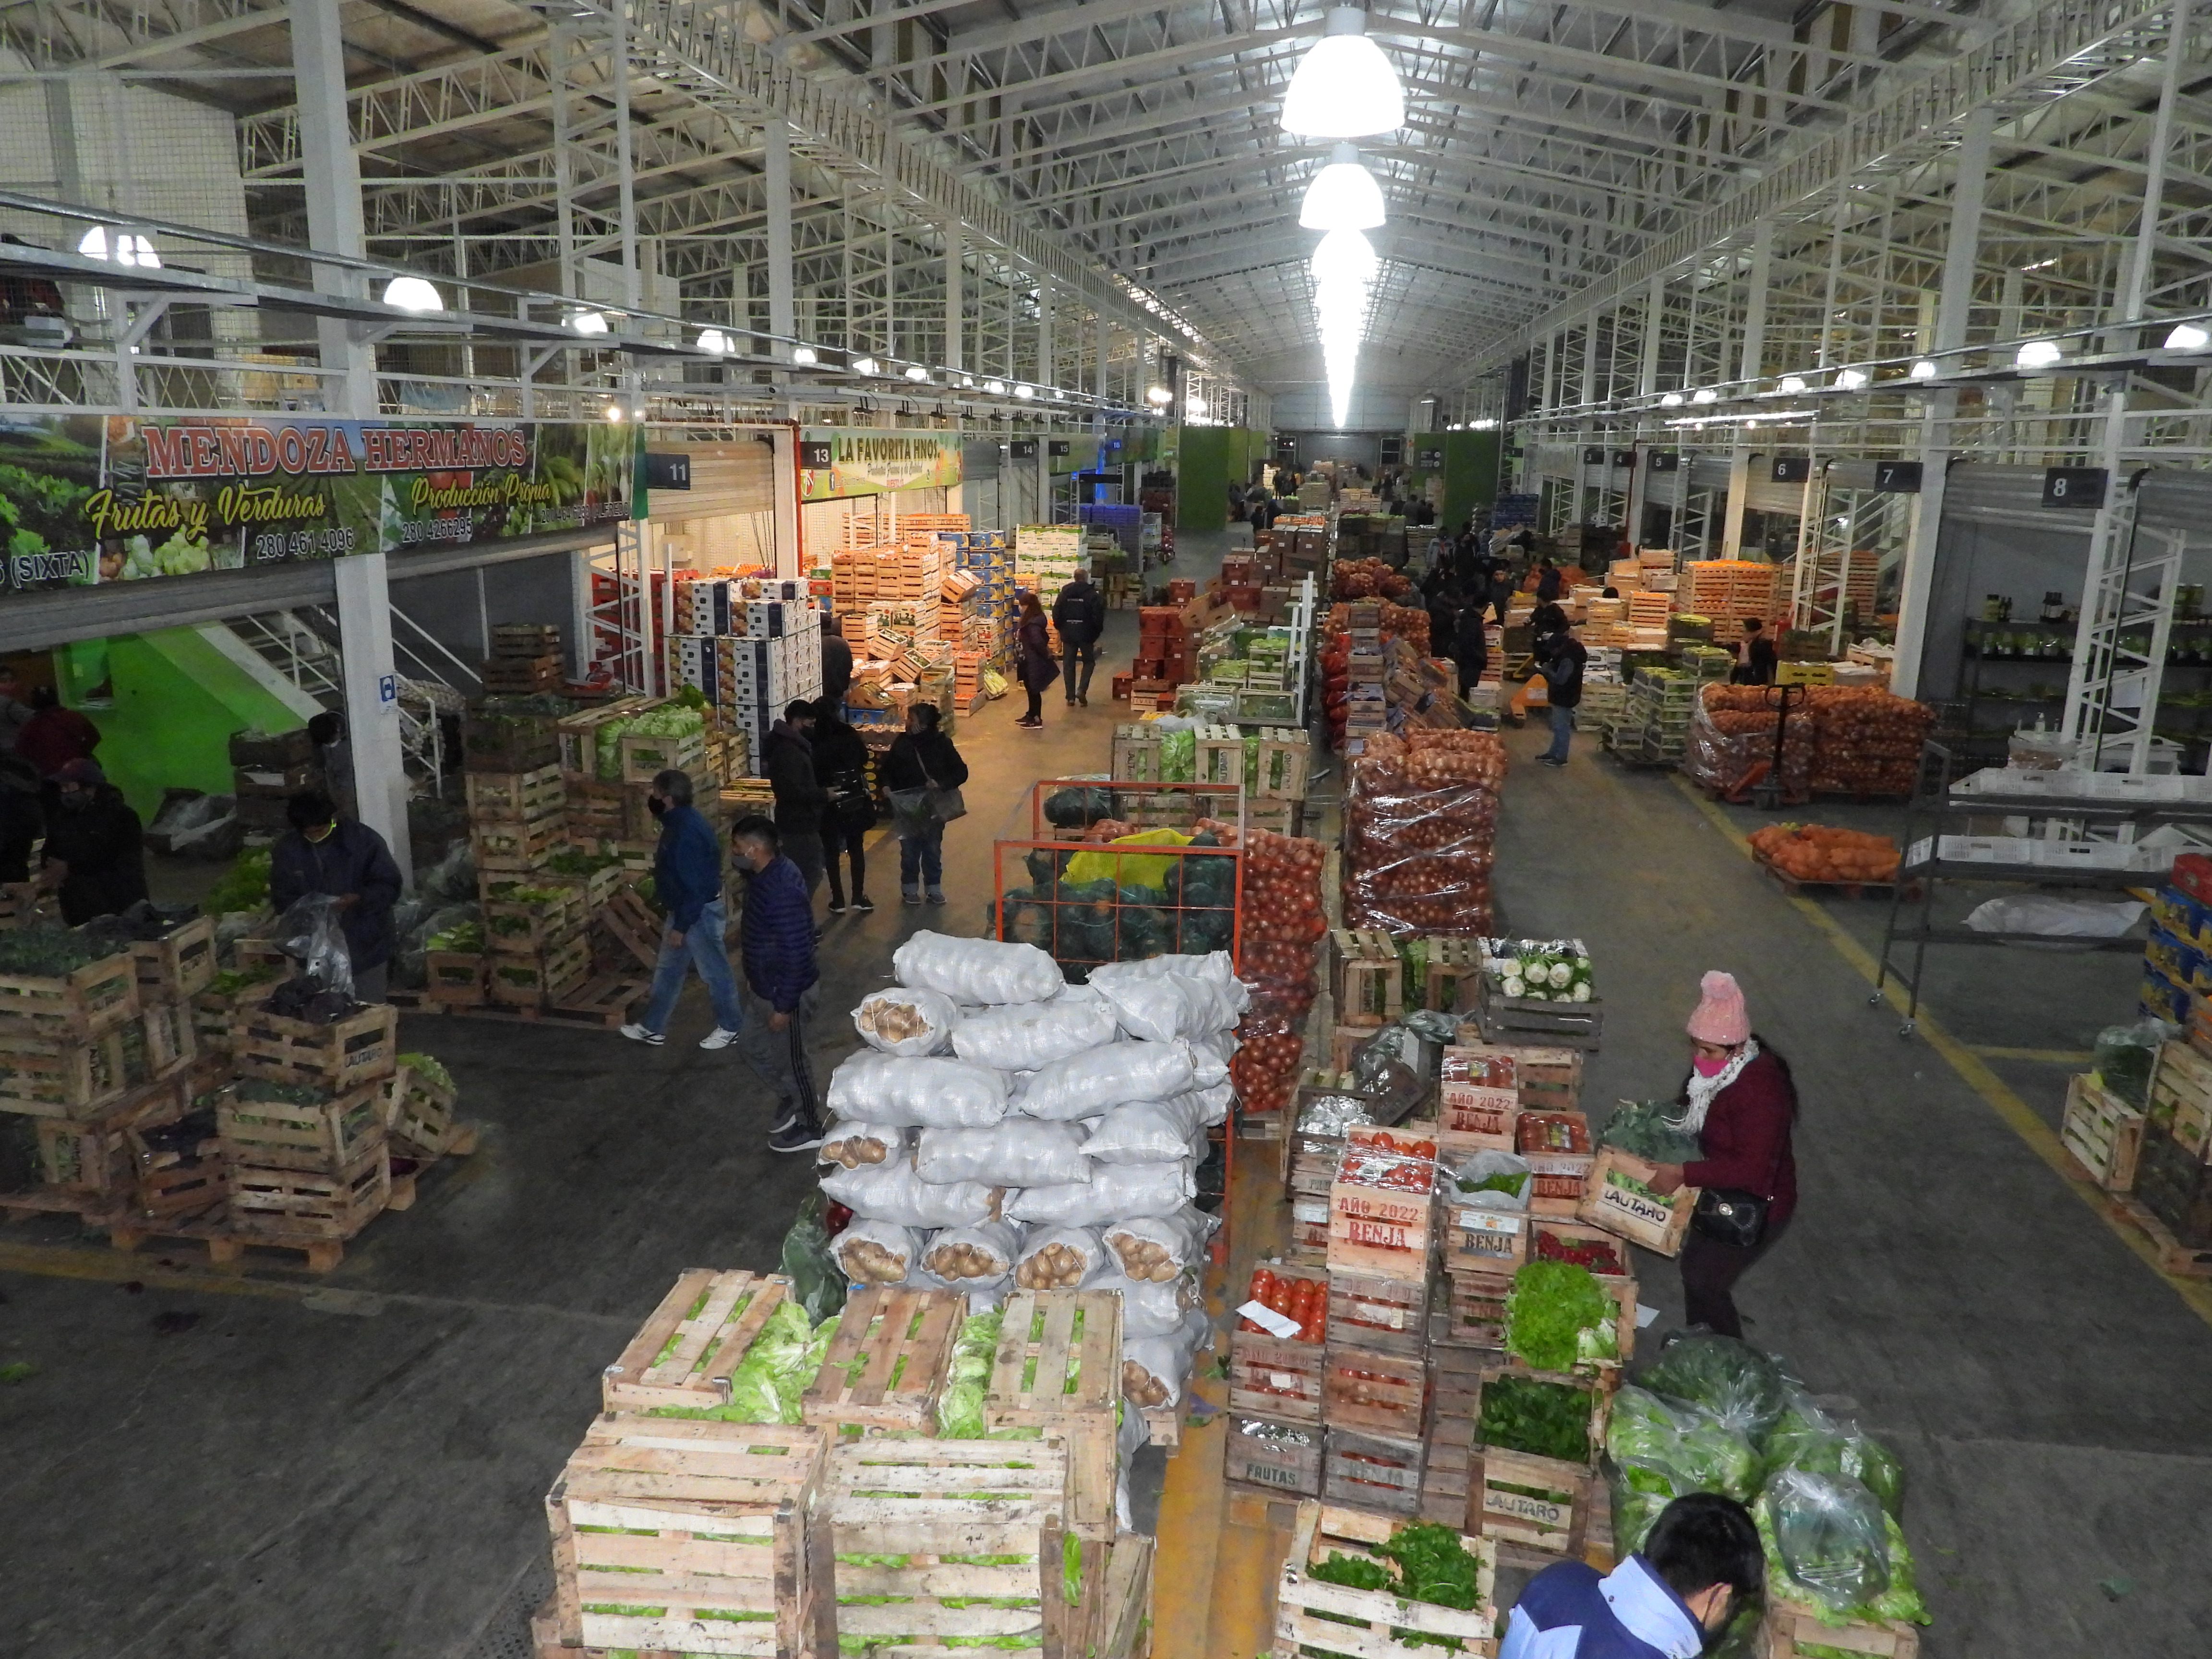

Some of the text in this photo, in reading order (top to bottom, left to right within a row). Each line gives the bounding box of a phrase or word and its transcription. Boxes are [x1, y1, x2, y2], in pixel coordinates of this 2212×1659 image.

[141, 425, 527, 479] MENDOZA HERMANOS
[814, 448, 830, 463] 13
[838, 437, 940, 463] LA FAVORITA HNOS.
[1023, 445, 1033, 455] 14
[1059, 445, 1069, 453] 15
[1616, 455, 1622, 463] 4
[669, 462, 687, 481] 11
[1655, 457, 1662, 467] 5
[1778, 464, 1786, 476] 6
[1883, 469, 1894, 484] 7
[410, 473, 552, 516] Producción Propia
[2053, 478, 2068, 497] 8
[85, 482, 326, 541] Frutas y Verduras
[541, 508, 555, 524] 280
[401, 517, 474, 543] 280 4266295
[256, 527, 356, 560] 280 461 4096
[11, 550, 90, 589] (SIXTA)
[1219, 752, 1228, 783] AUTARO
[1449, 1092, 1512, 1110] AÑO 2022
[1537, 1179, 1581, 1196] BENJA
[1339, 1197, 1419, 1221] AÑO 2022
[1349, 1221, 1407, 1248] BENJA
[1465, 1234, 1513, 1254] BENJA
[1246, 1462, 1296, 1485] FRUTAS
[1485, 1493, 1560, 1521] LAUTARO
